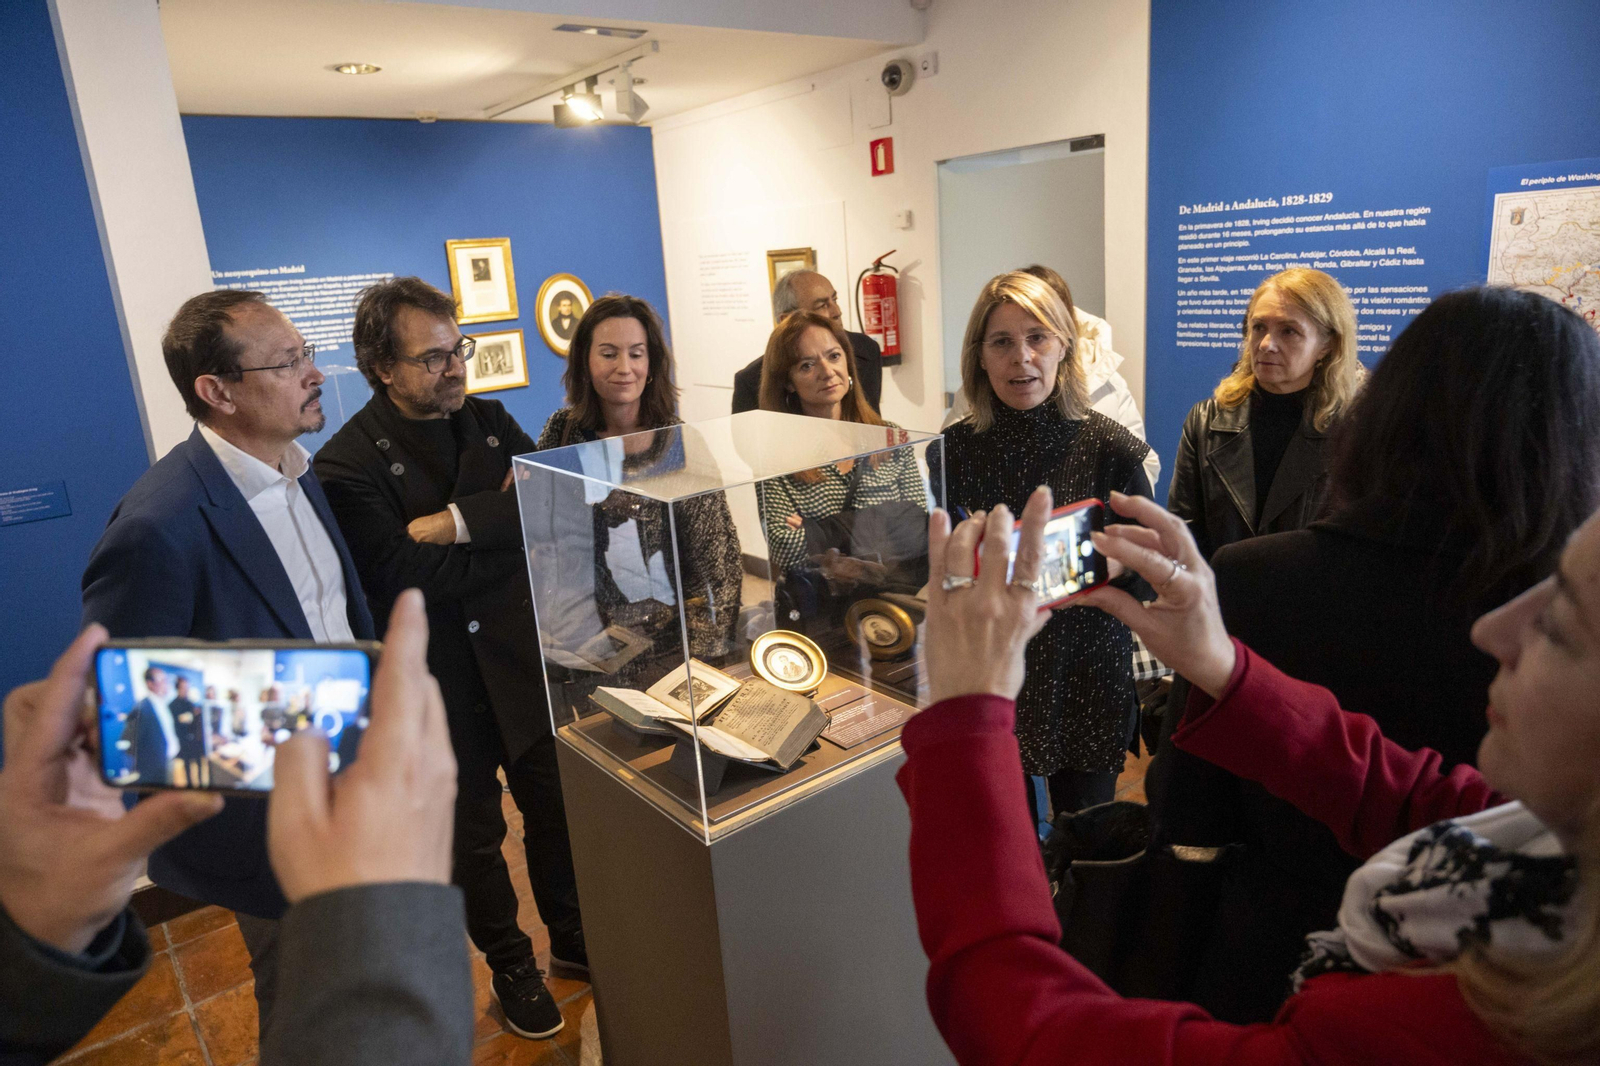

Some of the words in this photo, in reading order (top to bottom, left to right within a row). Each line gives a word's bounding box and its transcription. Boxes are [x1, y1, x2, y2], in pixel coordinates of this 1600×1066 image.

[1529, 176, 1555, 186] periplo
[1179, 205, 1191, 215] De
[1193, 202, 1223, 213] Madrid
[1232, 198, 1279, 210] Andalucía,
[1282, 192, 1333, 206] 1828-1829
[1194, 223, 1223, 231] primavera
[1324, 211, 1361, 220] Andalucía.
[1406, 206, 1431, 216] región
[1254, 227, 1294, 237] prolongando
[1387, 220, 1402, 229] que
[1403, 218, 1426, 226] había
[1178, 243, 1204, 251] planeado
[1223, 240, 1250, 248] principio.
[1270, 252, 1298, 260] Carolina,
[1300, 251, 1327, 259] Andújar,
[1363, 248, 1386, 256] Alcalá
[224, 269, 269, 278] neoyorquino
[279, 265, 305, 273] Madrid
[1359, 323, 1385, 332] amigos
[718, 684, 754, 722] HISTORIA
